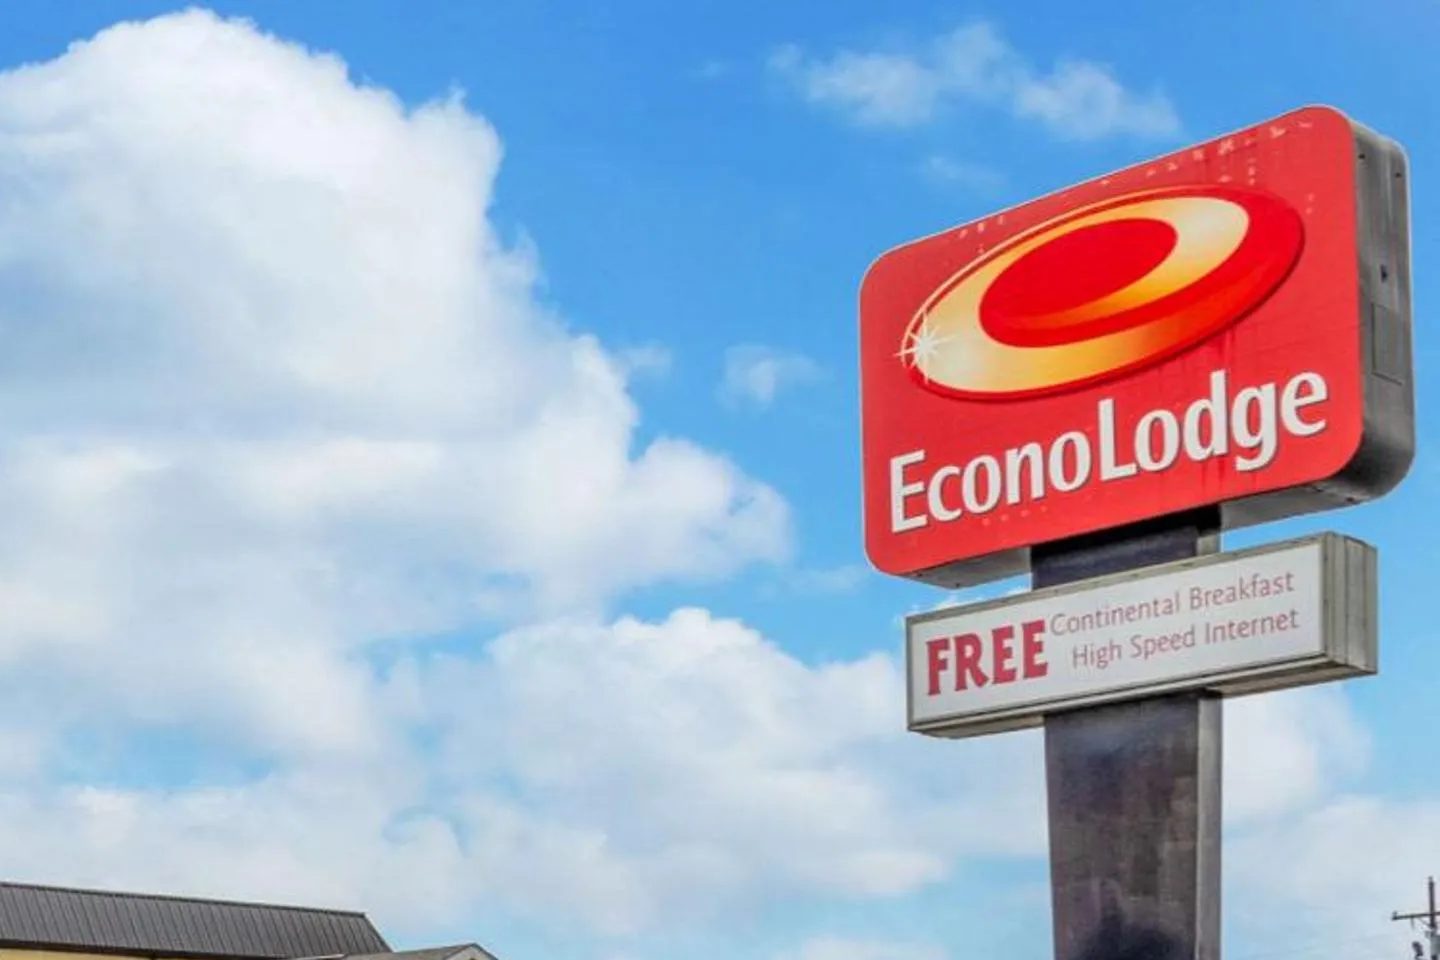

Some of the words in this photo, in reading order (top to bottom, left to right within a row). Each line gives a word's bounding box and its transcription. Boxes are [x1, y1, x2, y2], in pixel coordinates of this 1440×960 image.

[889, 369, 1328, 534] EconoLodge
[1050, 594, 1180, 637] Continental
[1189, 571, 1294, 611] Breakfast
[1072, 638, 1123, 670] High
[1130, 626, 1196, 660] Speed
[1204, 608, 1300, 645] Internet
[926, 619, 1048, 696] FREE
